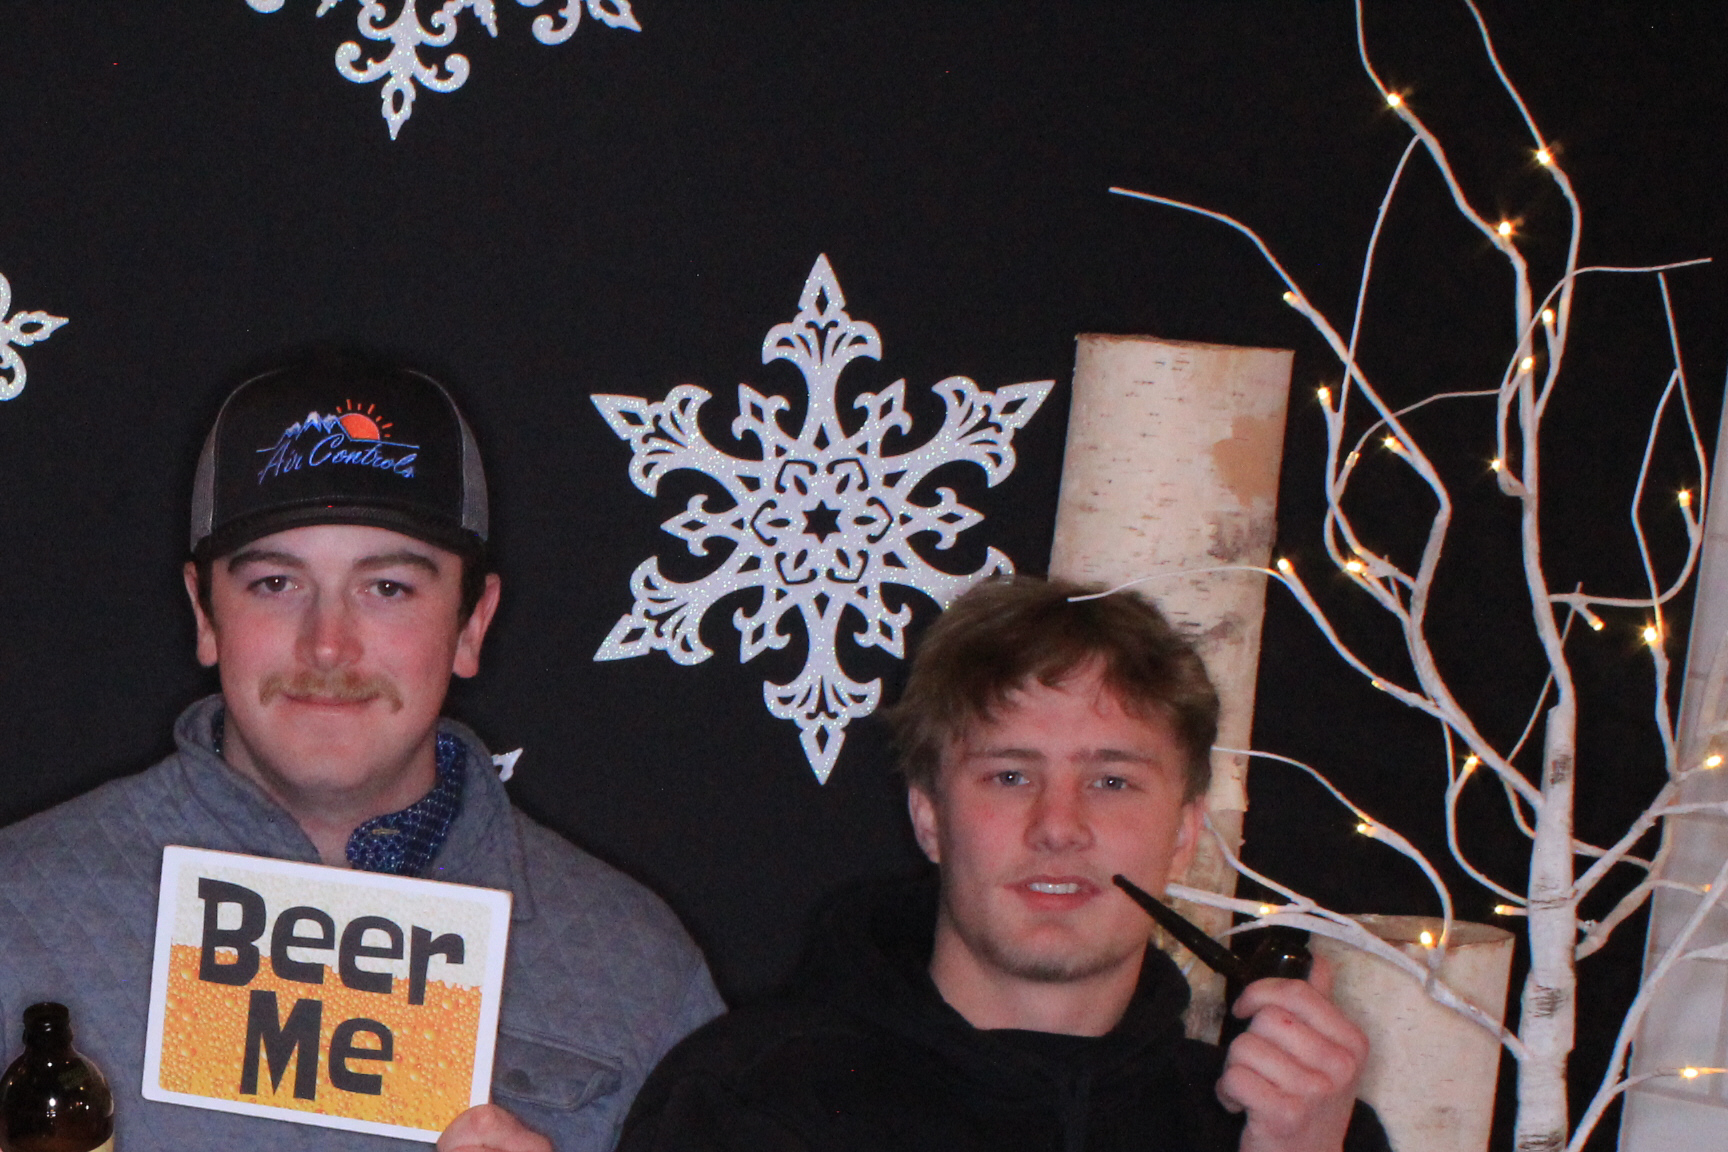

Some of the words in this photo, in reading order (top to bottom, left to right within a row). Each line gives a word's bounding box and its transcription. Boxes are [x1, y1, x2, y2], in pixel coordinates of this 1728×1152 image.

[257, 440, 303, 485] Air
[308, 433, 418, 478] Controls
[198, 877, 465, 1006] Beer
[239, 989, 394, 1102] Me
